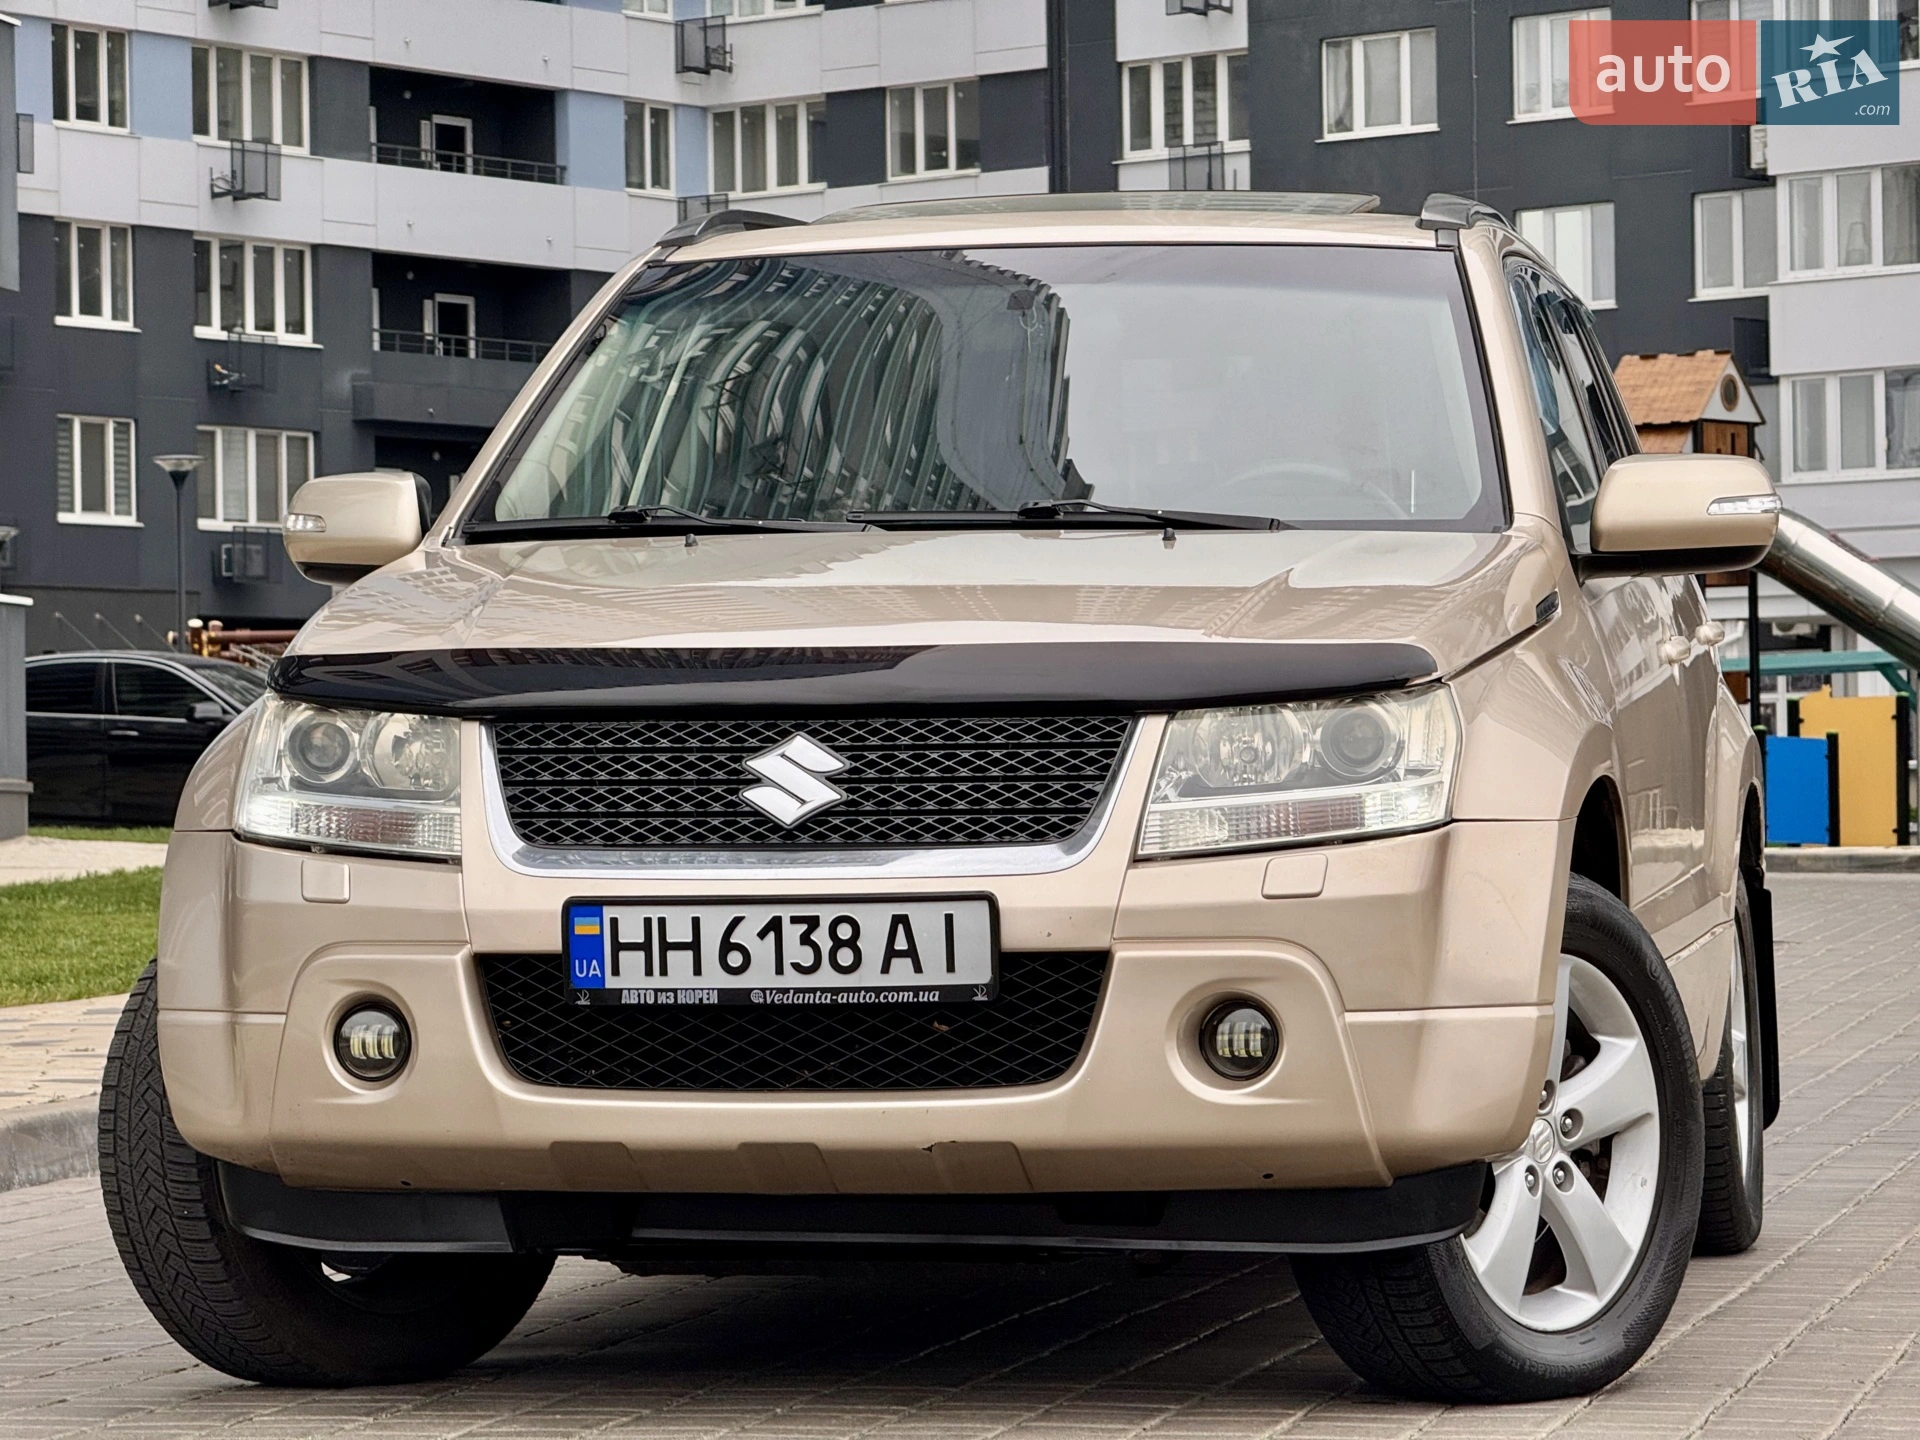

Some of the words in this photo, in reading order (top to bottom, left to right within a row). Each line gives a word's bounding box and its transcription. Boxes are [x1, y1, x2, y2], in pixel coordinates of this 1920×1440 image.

[609, 914, 702, 977] HH
[718, 914, 863, 976] 6138
[880, 912, 956, 975] AI
[575, 959, 602, 978] UA
[621, 989, 655, 1004] АВТО
[677, 989, 718, 1004] КОРЕИ
[765, 989, 940, 1004] Vedanta-auto.com.ua
